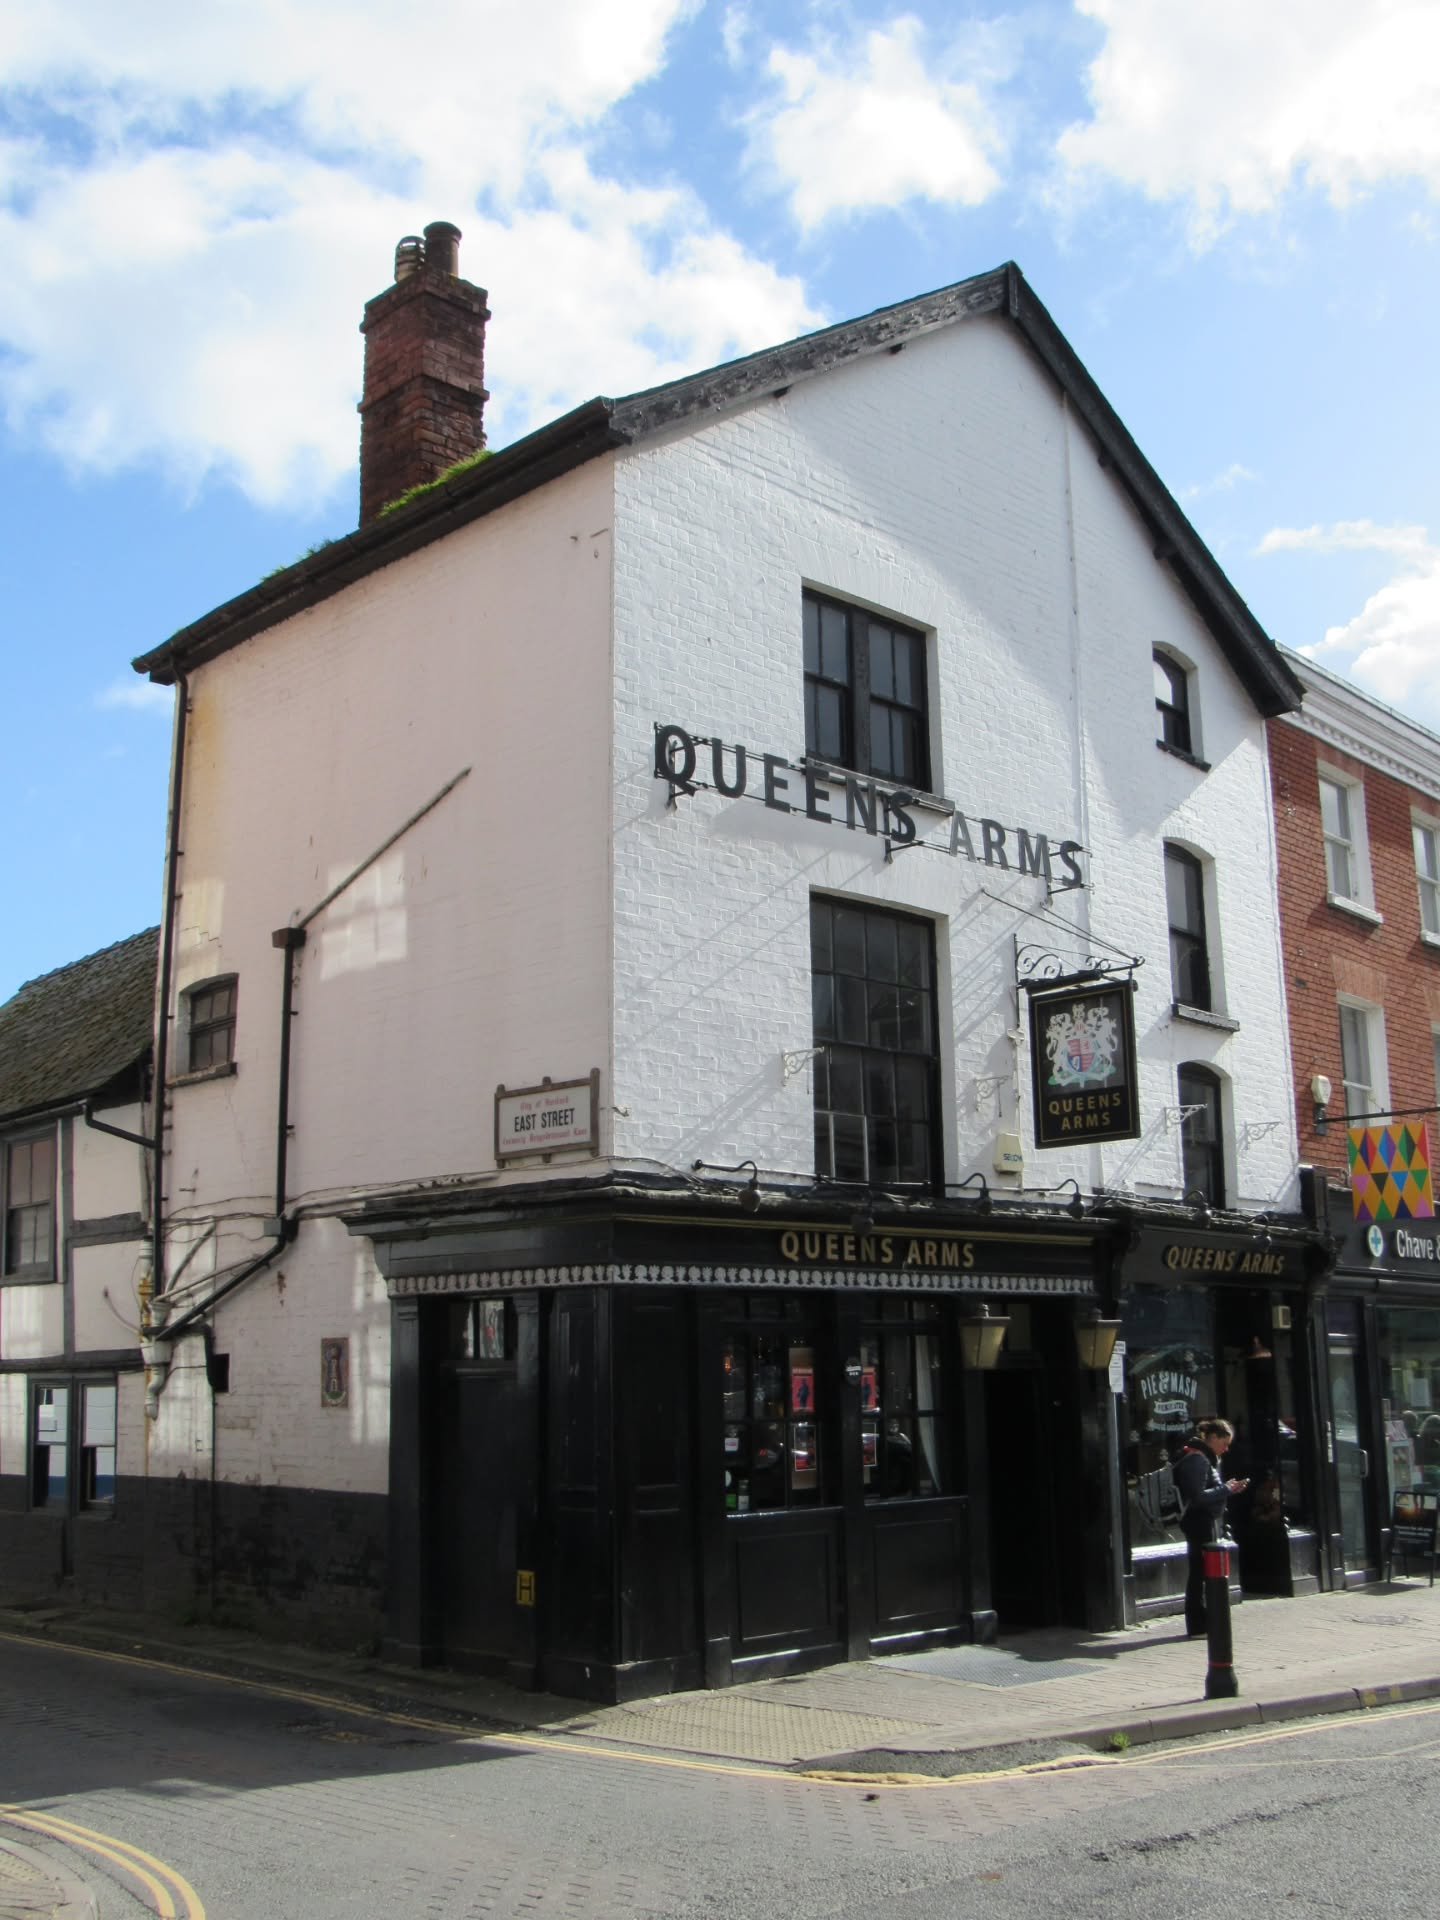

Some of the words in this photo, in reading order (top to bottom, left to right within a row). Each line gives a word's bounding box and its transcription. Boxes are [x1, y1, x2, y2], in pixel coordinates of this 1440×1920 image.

[655, 725, 916, 844] QUEENS
[949, 810, 1082, 887] ARMS
[1049, 1092, 1121, 1115] QUEENS
[514, 1114, 536, 1133] EAST
[541, 1108, 575, 1129] STREET
[1061, 1112, 1111, 1131] ARMS
[781, 1231, 893, 1263] QUEENS
[906, 1239, 975, 1267] ARMS
[1396, 1229, 1434, 1260] Chave
[1167, 1245, 1236, 1271] QUEENS
[1240, 1252, 1285, 1275] ARMS
[1141, 1374, 1158, 1400] PIE
[1170, 1371, 1198, 1400] MASH
